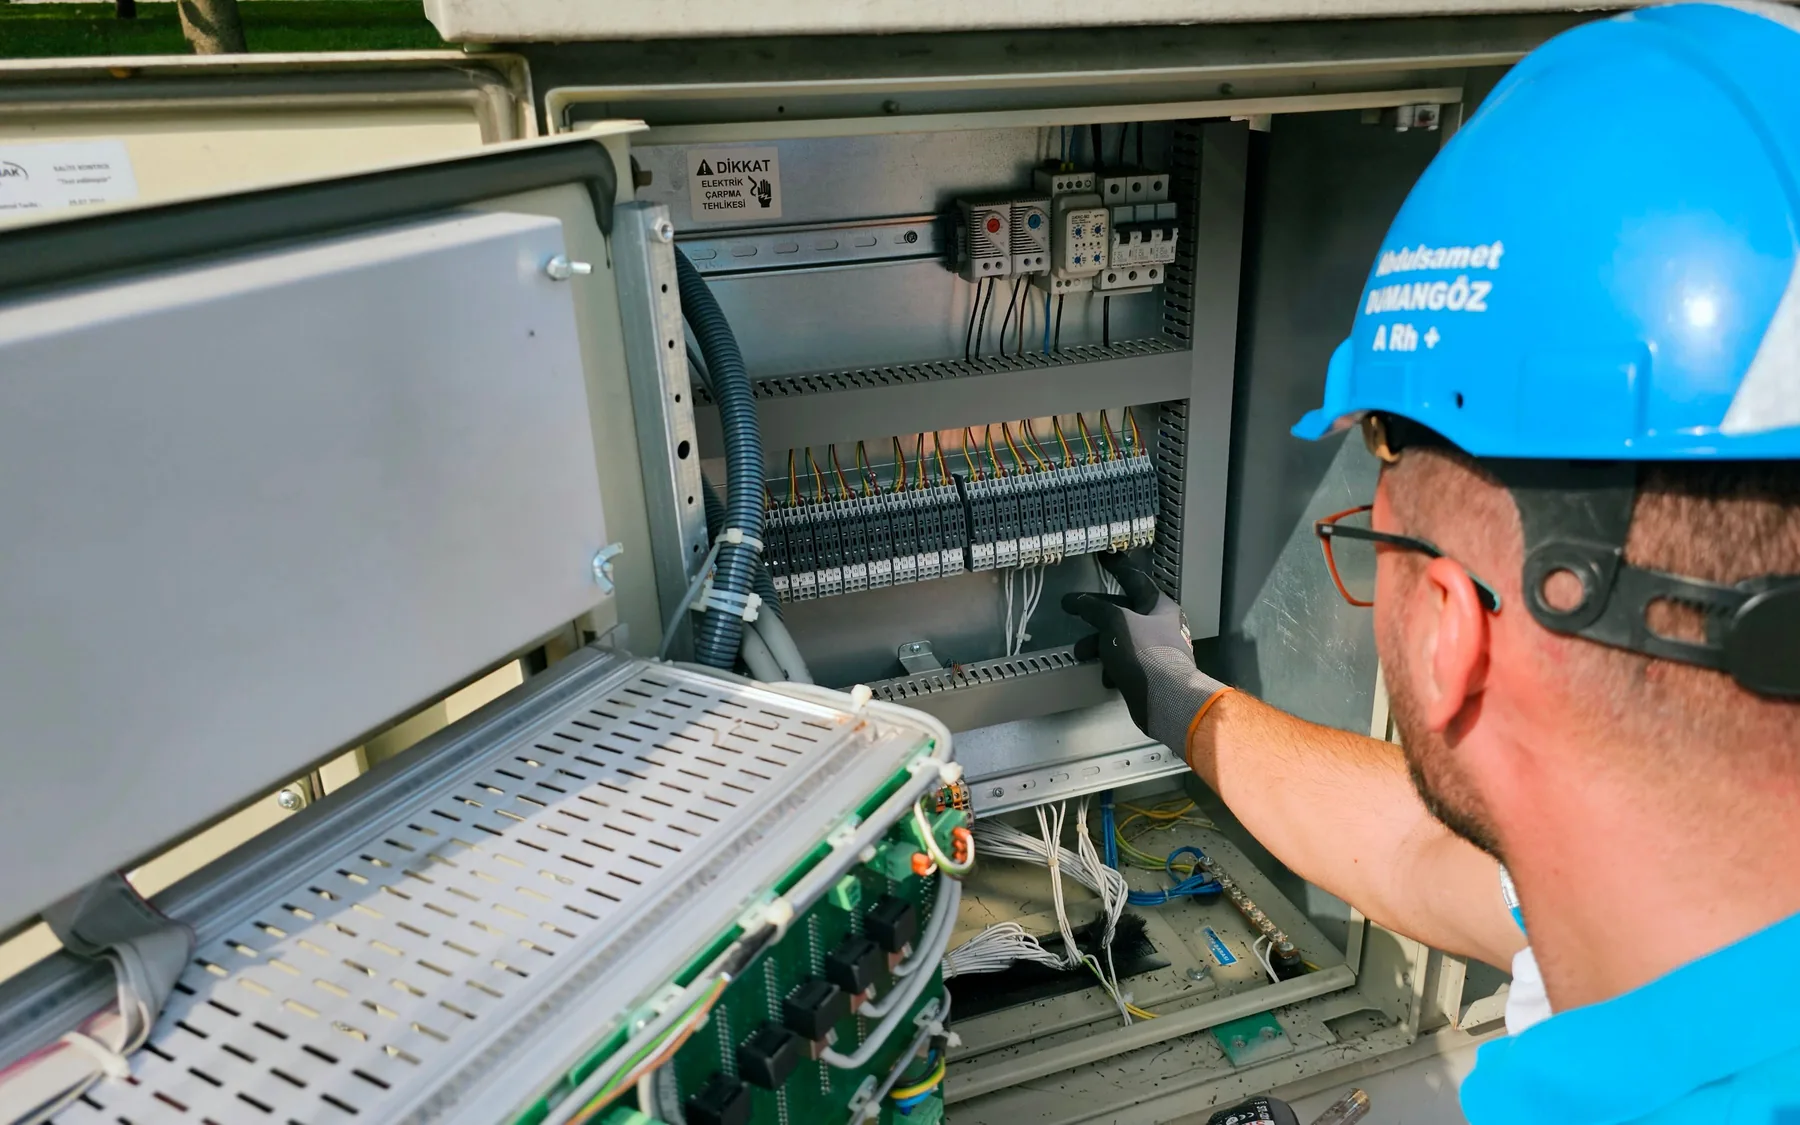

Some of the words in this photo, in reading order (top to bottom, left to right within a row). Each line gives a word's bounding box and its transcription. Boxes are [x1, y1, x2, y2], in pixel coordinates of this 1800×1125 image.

[717, 158, 771, 174] DİKKAT
[0, 168, 20, 177] AK
[701, 177, 743, 188] ELEKTRİK
[705, 190, 741, 200] ÇARPMA
[703, 199, 746, 210] TEHLİKESİ
[1375, 240, 1505, 277] Abdulsamet
[1372, 324, 1387, 352] A
[1388, 322, 1419, 352] Rh
